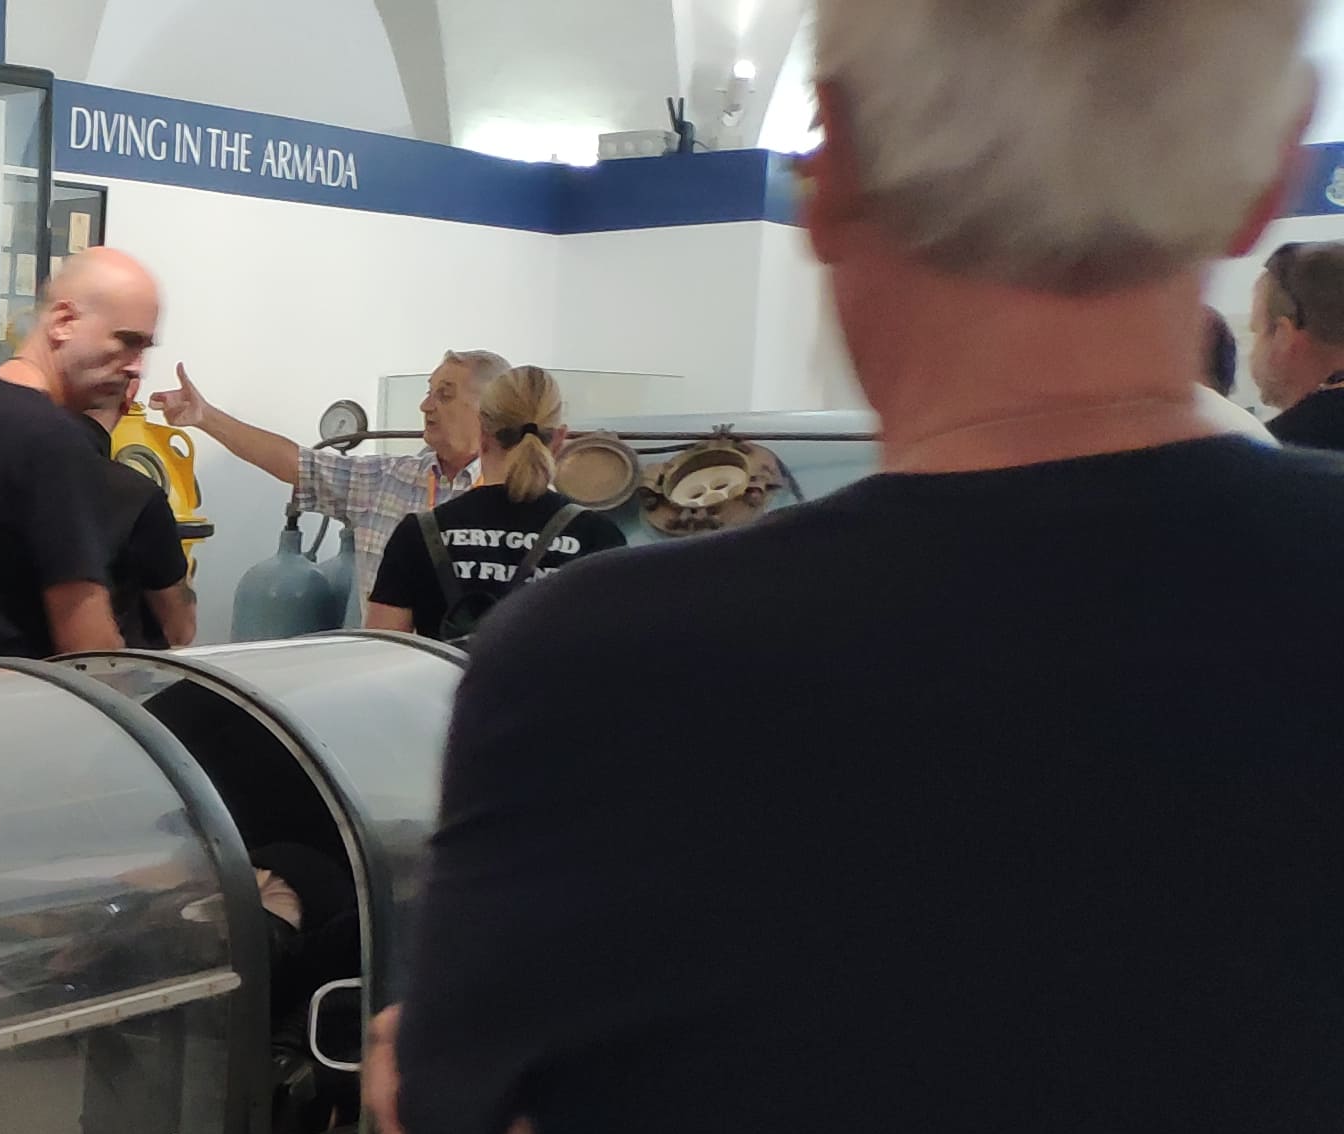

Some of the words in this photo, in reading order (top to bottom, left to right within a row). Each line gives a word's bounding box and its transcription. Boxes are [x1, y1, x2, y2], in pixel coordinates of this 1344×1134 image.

[70, 106, 168, 161] DIVING
[174, 122, 202, 166] IN
[206, 127, 254, 173] THE
[260, 139, 359, 190] ARMADA
[440, 529, 506, 547] VERY
